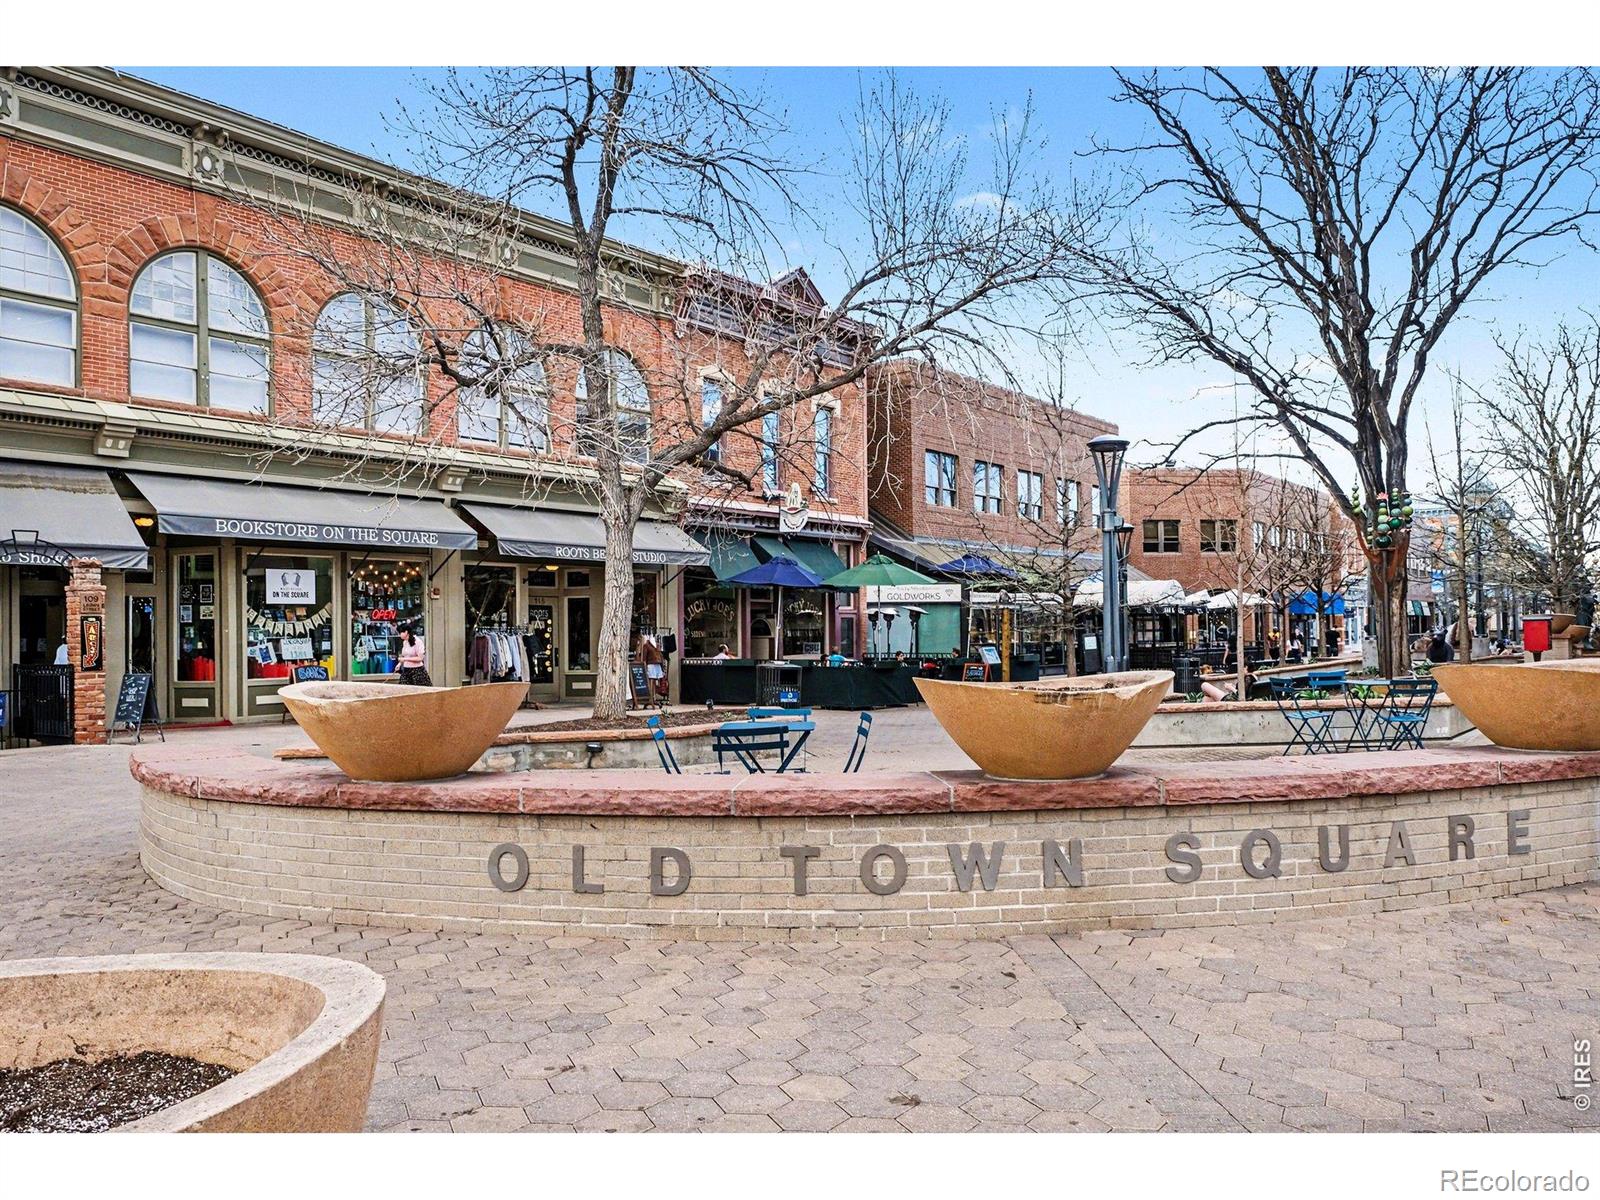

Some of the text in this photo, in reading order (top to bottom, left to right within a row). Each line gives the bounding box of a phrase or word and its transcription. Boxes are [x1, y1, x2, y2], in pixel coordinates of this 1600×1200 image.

[215, 519, 439, 545] BOOKSTORE ON THE SQUARE
[555, 546, 590, 559] ROOTS
[632, 551, 667, 563] STUDIO
[84, 595, 99, 603] 109
[886, 592, 942, 601] GOLDWORKS
[371, 609, 397, 620] OPEN
[685, 599, 711, 622] LUCKY
[297, 666, 327, 680] BOOKS
[487, 809, 1532, 897] OLD TOWN SQUARE
